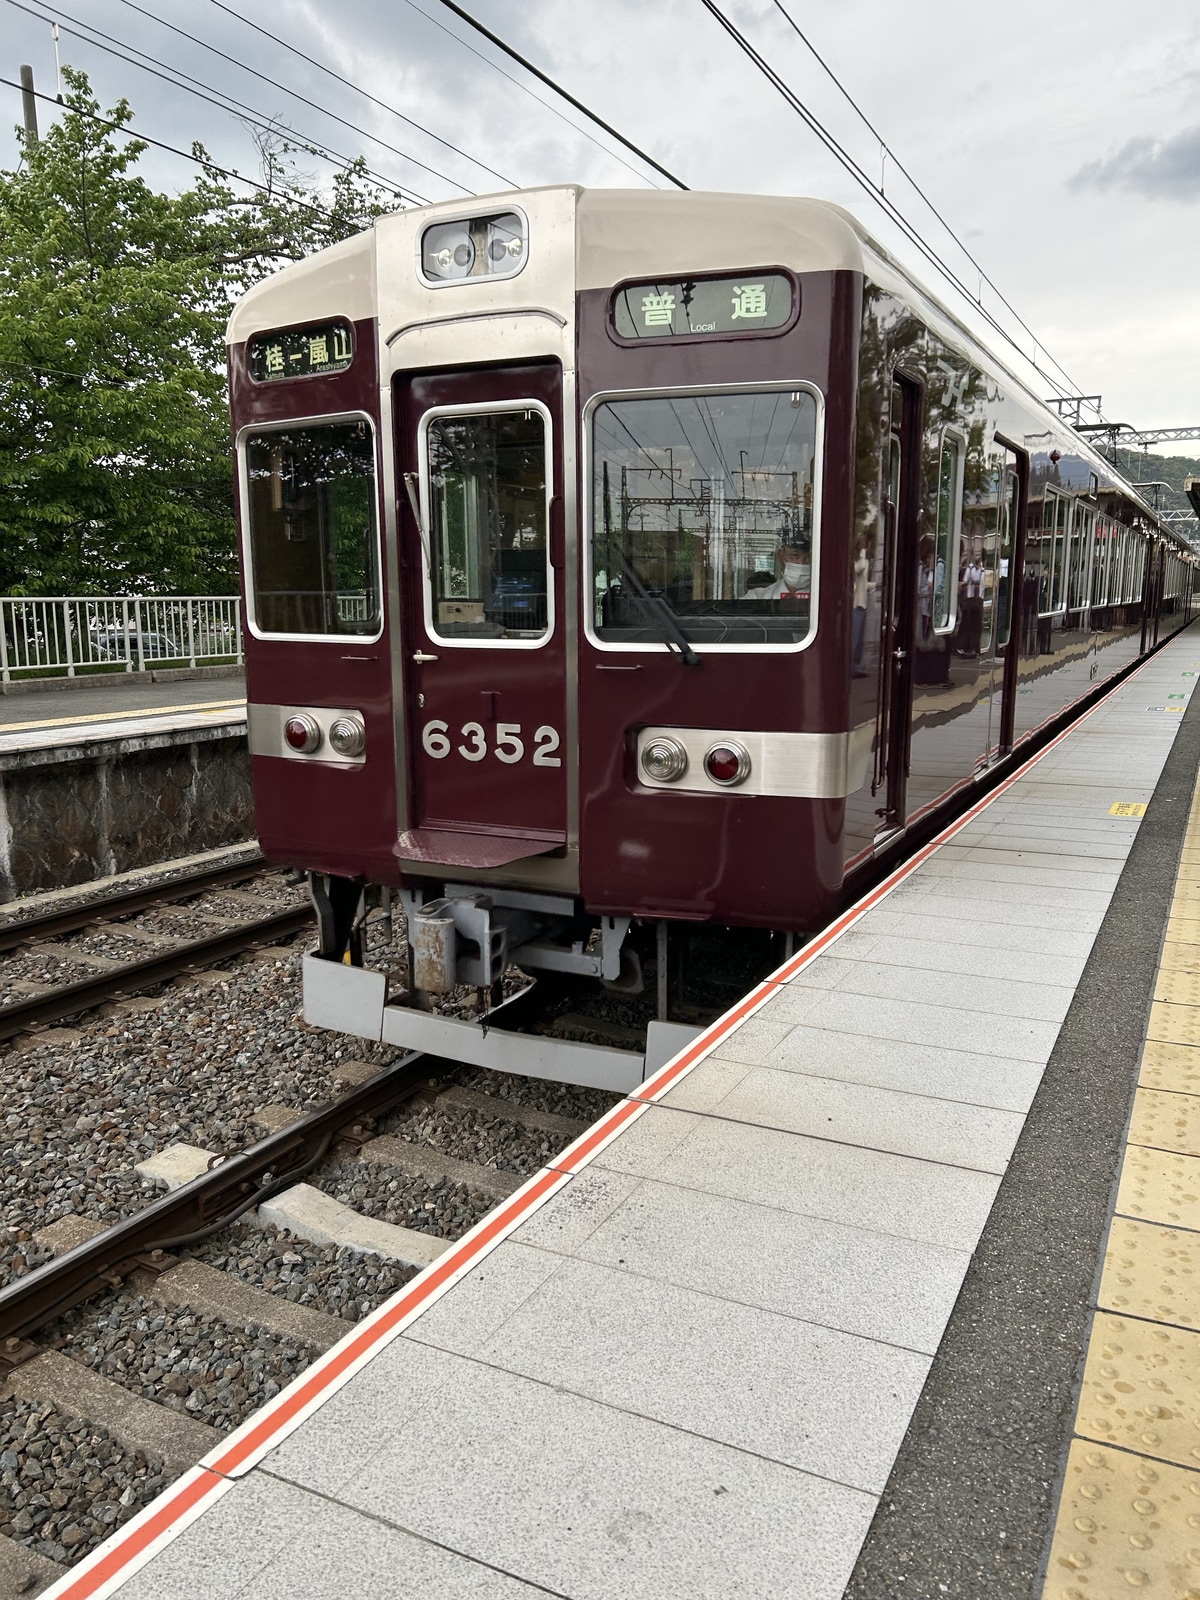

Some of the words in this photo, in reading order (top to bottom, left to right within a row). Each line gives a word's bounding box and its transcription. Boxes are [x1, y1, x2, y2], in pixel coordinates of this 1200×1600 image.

[641, 284, 768, 326] 普通
[690, 321, 716, 332] Local
[422, 719, 562, 768] 6352
